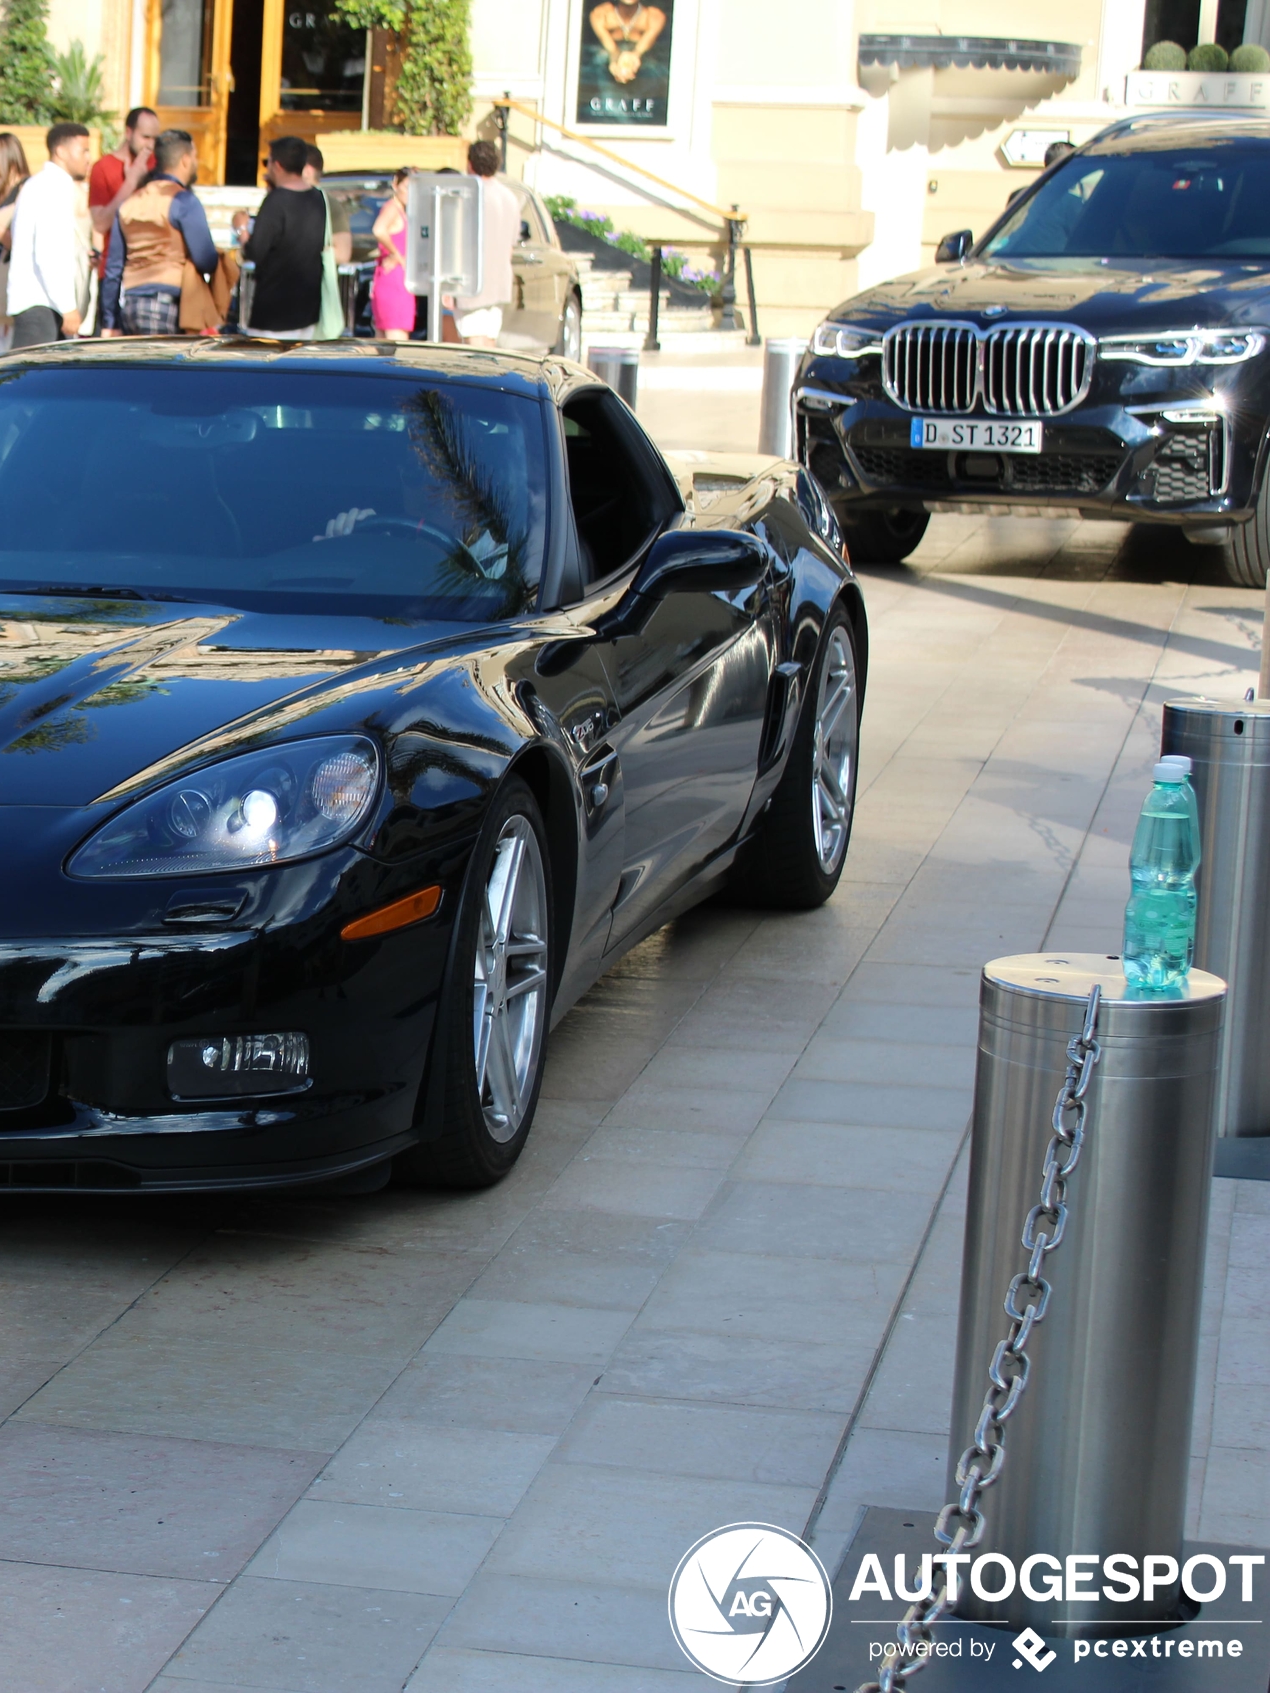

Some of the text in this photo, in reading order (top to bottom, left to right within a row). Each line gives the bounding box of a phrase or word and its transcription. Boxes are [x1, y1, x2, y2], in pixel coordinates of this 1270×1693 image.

[1139, 82, 1263, 101] GRAFF
[590, 97, 654, 112] GRAFF
[925, 424, 1036, 447] D ST 1321
